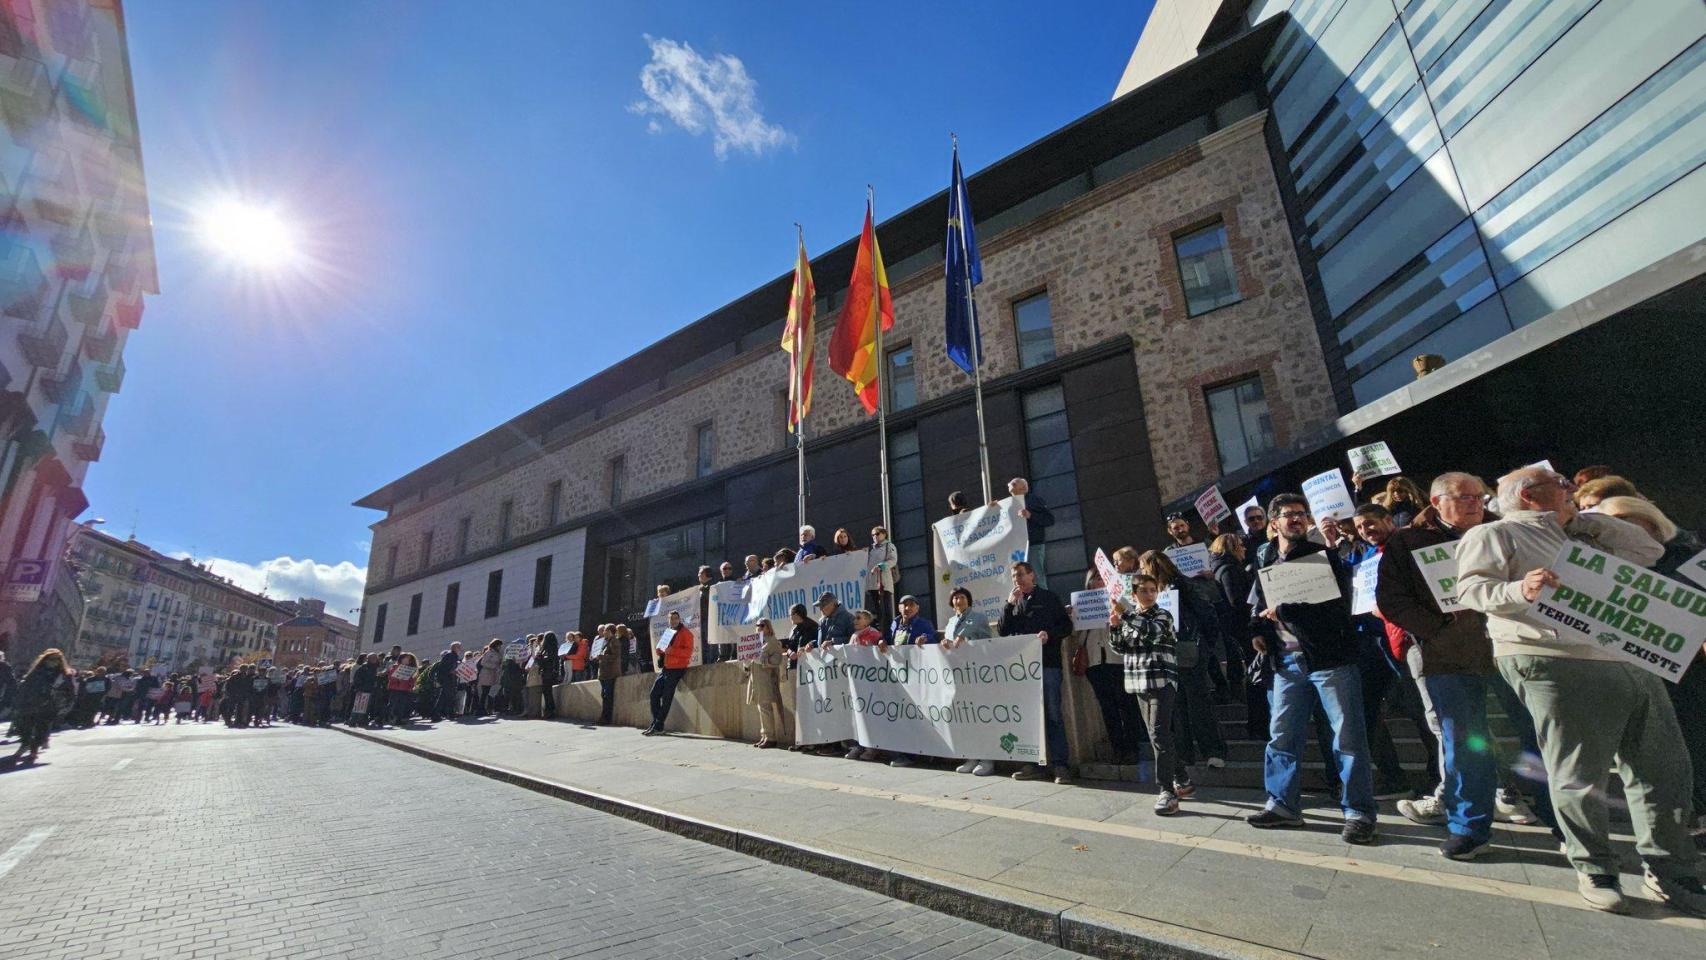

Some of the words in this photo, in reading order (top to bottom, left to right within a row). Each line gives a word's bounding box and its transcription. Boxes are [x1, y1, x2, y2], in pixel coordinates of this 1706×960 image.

[1419, 547, 1451, 565] LA
[969, 565, 1004, 581] SANIDAD
[1567, 546, 1607, 575] LA
[1613, 564, 1706, 617] SALUD
[767, 588, 807, 620] SANIDAD
[1606, 585, 1650, 614] LO
[1551, 584, 1686, 654] PRIMERO
[1537, 602, 1592, 635] TERUEL
[1621, 641, 1683, 675] EXISTE
[799, 664, 814, 686] La
[918, 666, 938, 685] no
[944, 654, 1042, 685] entiende
[814, 695, 833, 714] de
